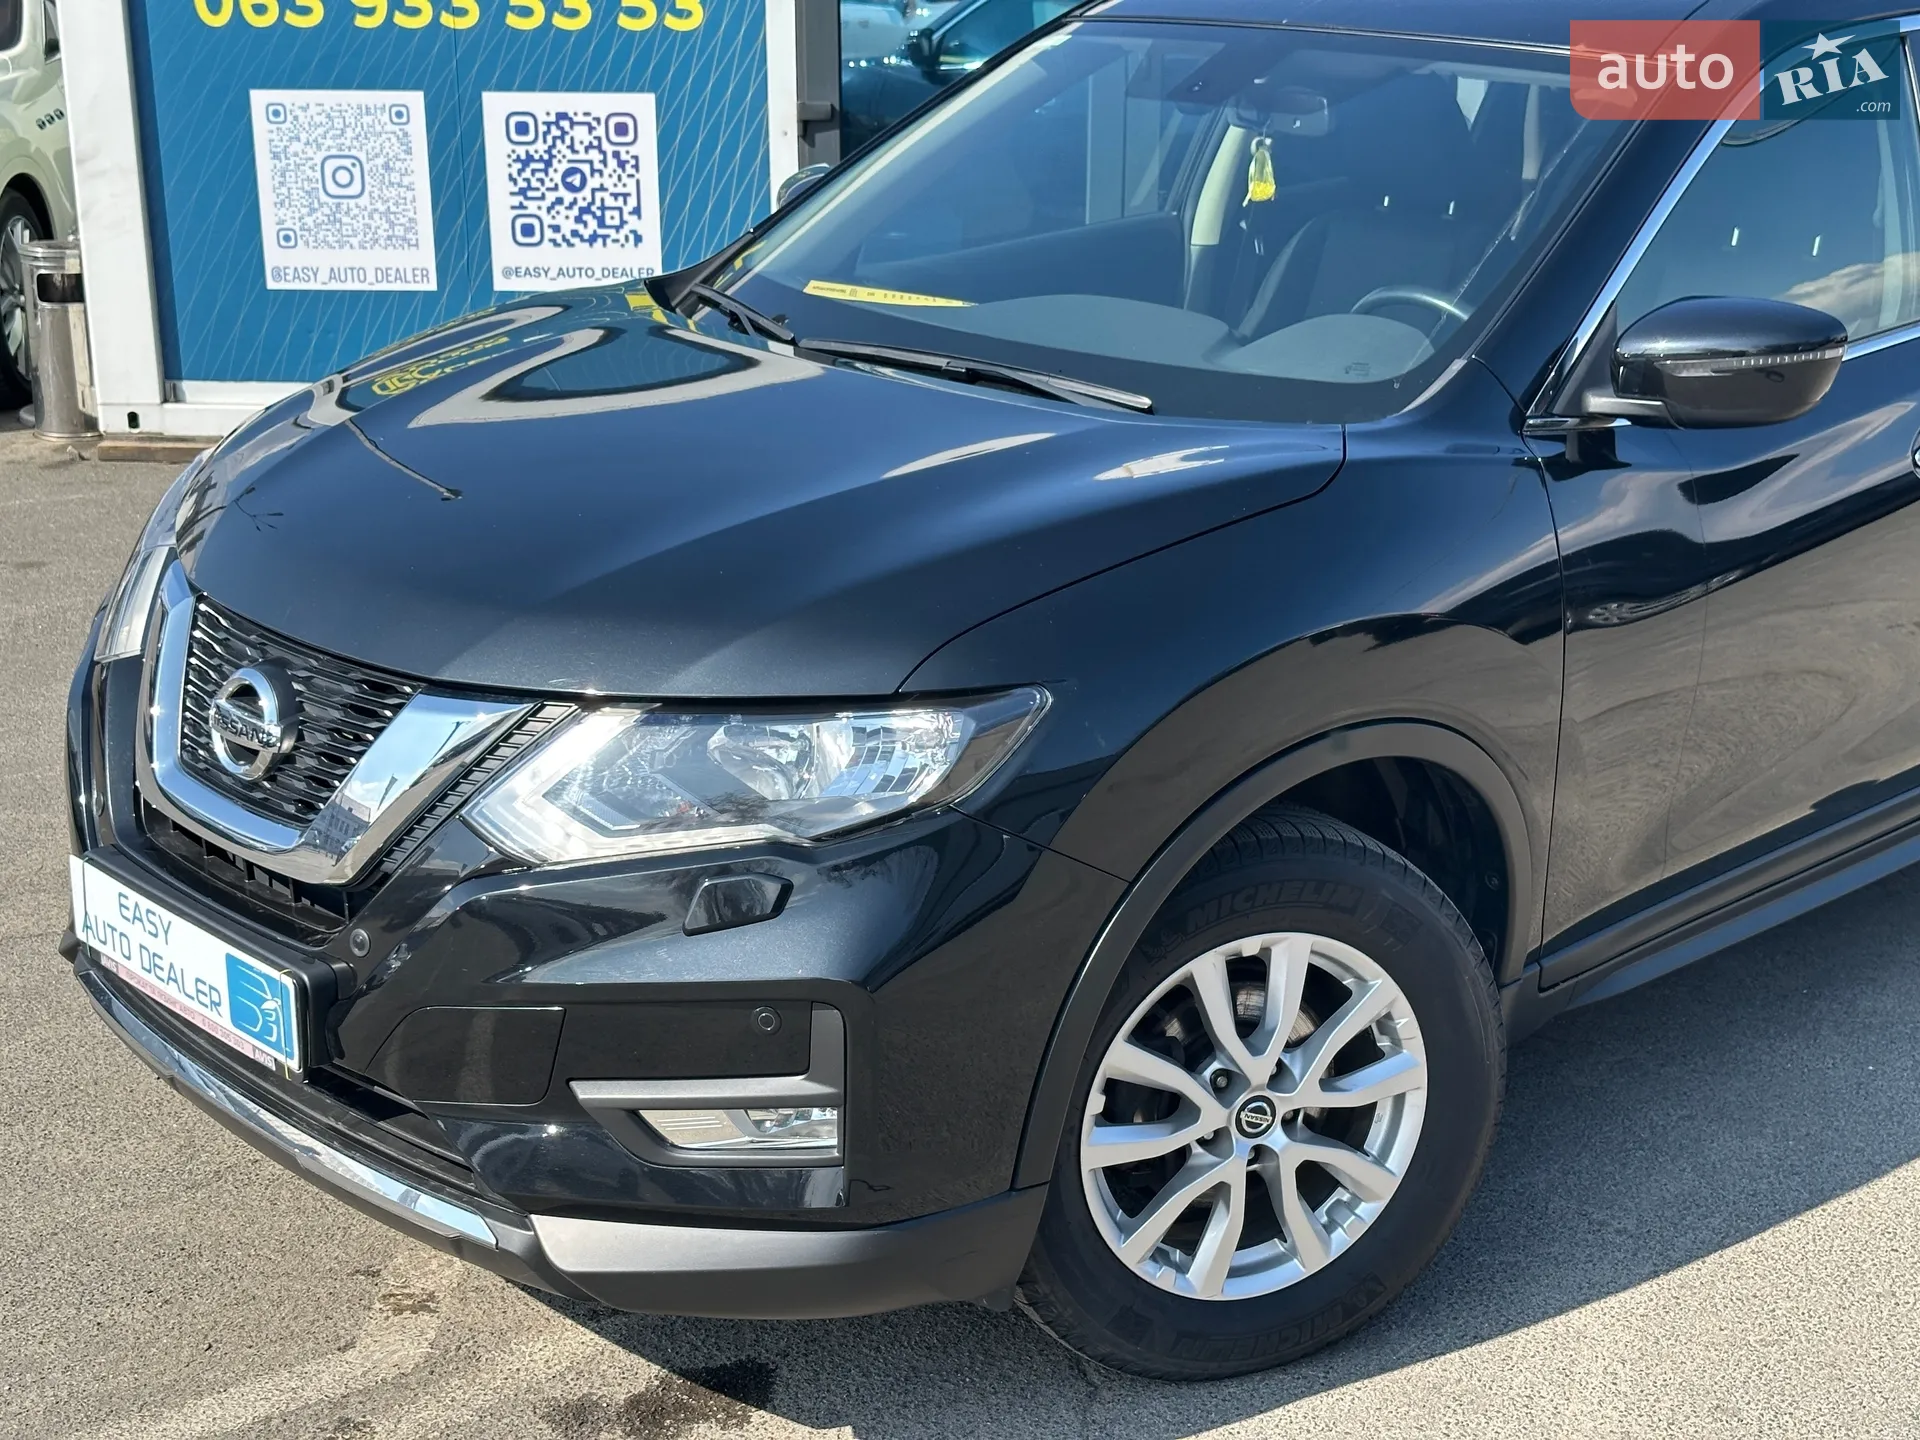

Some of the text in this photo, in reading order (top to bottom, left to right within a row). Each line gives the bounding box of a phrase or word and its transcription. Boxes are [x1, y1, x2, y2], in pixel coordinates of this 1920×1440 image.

[193, 0, 704, 31] 063 933 53 53
[271, 266, 430, 285] @EASY_AUTO_DEALER
[118, 891, 172, 946] EASY
[1186, 880, 1362, 931] MICHELIN
[82, 911, 223, 1018] AUTO DEALER
